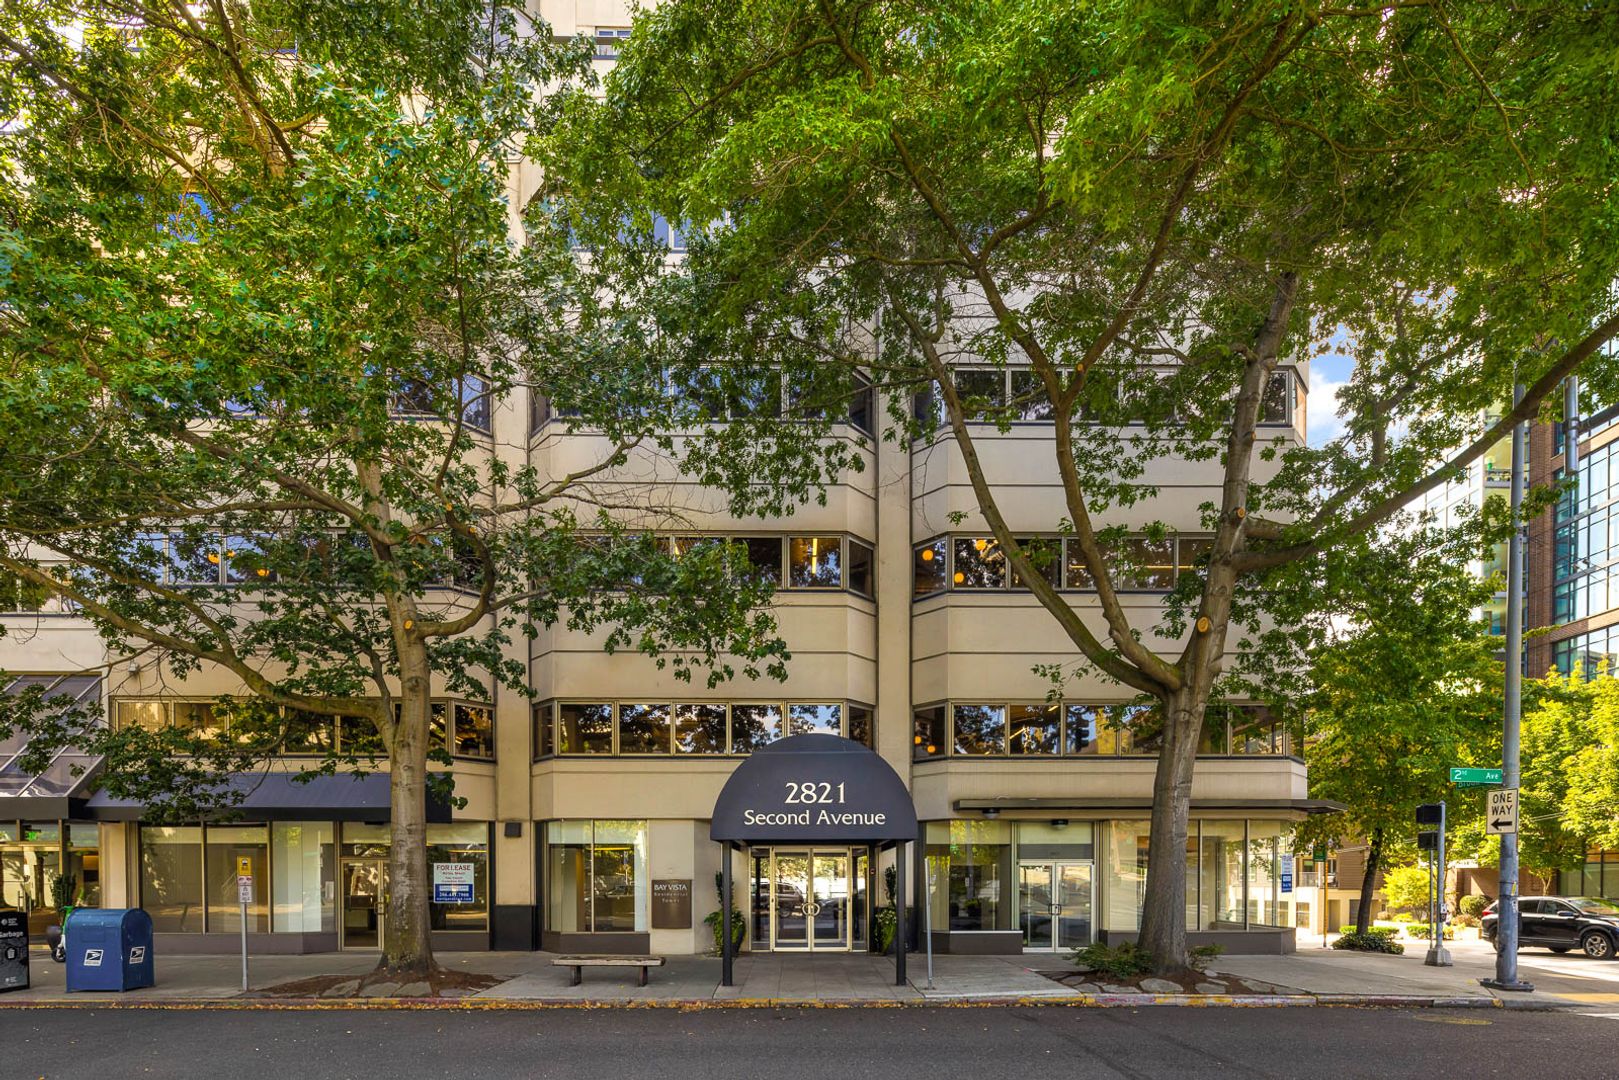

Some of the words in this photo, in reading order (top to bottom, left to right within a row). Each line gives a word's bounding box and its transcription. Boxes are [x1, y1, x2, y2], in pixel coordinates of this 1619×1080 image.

[784, 782, 845, 804] 2821
[1493, 793, 1512, 803] ONE
[744, 809, 810, 825] Second
[816, 810, 886, 825] Avenue
[1492, 805, 1512, 816] WAY
